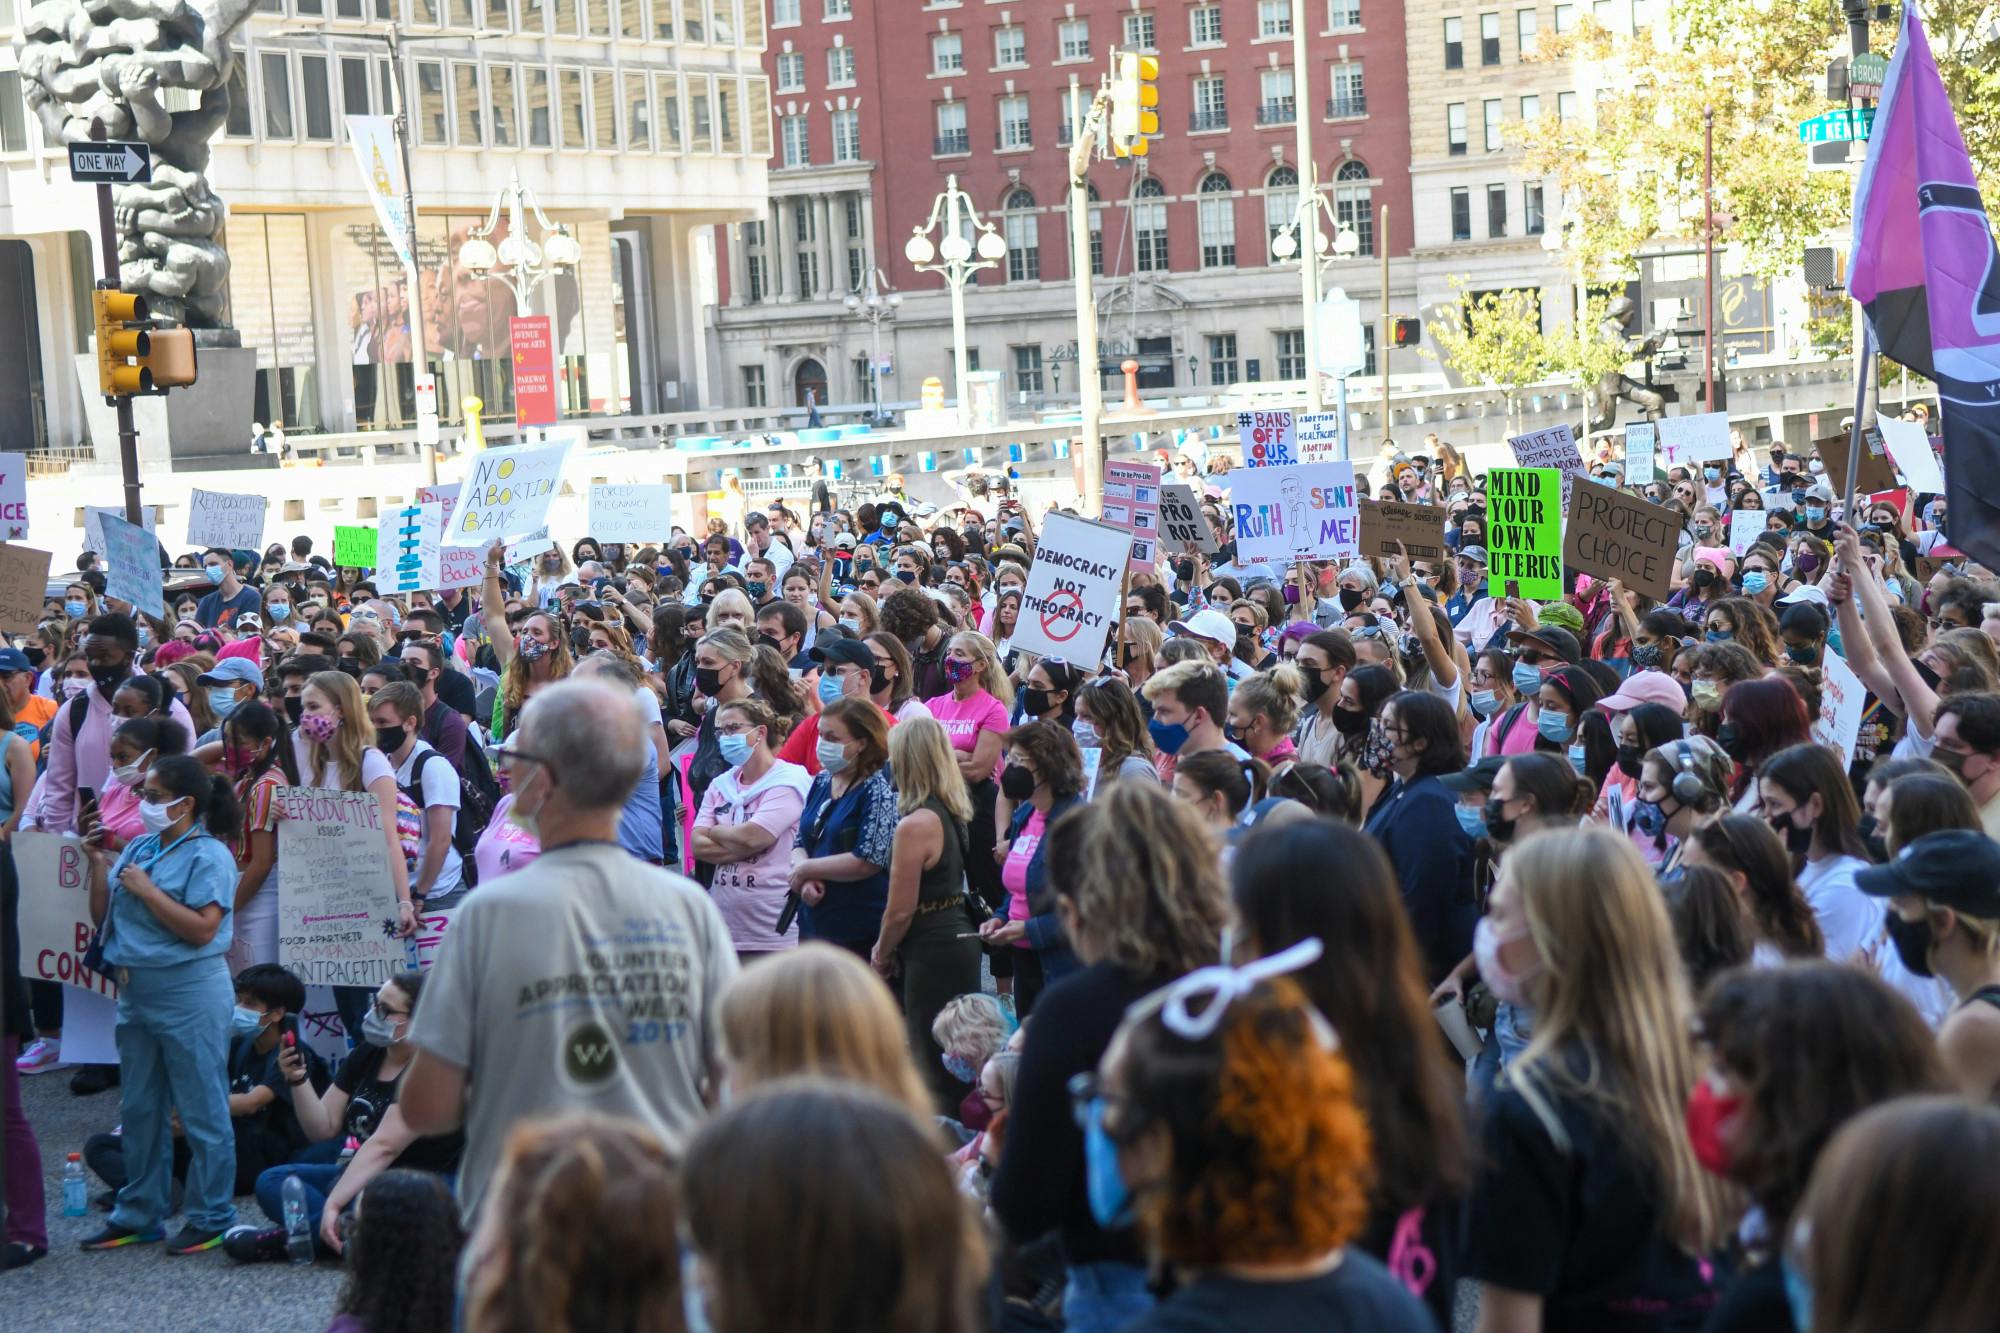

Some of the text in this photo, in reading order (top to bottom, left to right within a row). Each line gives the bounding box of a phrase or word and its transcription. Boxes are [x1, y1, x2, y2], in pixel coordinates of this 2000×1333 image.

[1858, 65, 1883, 82] BROAD
[1802, 121, 1871, 140] JF KENNE
[78, 154, 126, 170] ONE WAY
[514, 331, 539, 339] AVENUE
[530, 340, 546, 348] ARTS
[517, 376, 546, 384] PARKWAY
[517, 385, 548, 393] MUSEUMS
[1255, 412, 1291, 428] BANS
[1299, 414, 1334, 423] ABORTION
[1253, 428, 1285, 443] OFF
[1298, 430, 1337, 440] HEALTHCARE
[1511, 430, 1567, 453] NOLITE TE
[1252, 444, 1289, 459] OUR
[1302, 443, 1332, 452] ABORTION
[1516, 444, 1577, 466] BASTARDES
[475, 458, 516, 485] NO
[467, 479, 556, 508] ABORTION
[594, 487, 634, 499] FORCED
[1491, 471, 1541, 497] MIND
[193, 489, 264, 512] REPRODUCTIVE
[1310, 485, 1354, 509] SENT
[205, 511, 257, 526] FREEDOM
[1160, 504, 1193, 522] PRO
[1236, 503, 1284, 538] RUTH
[1491, 498, 1544, 524] YOUR
[1577, 491, 1673, 547] PROTECT
[462, 511, 516, 532] BANS
[1319, 516, 1357, 545] ME!
[193, 529, 262, 548] HUMAN RIGHT
[1167, 524, 1203, 541] ROE
[1492, 524, 1535, 551] OWN
[1036, 547, 1117, 580] DEMOCRACY
[1491, 552, 1560, 580] UTERUS
[1577, 533, 1658, 582] CHOICE
[442, 564, 482, 583] Back
[1054, 577, 1087, 597] NOT
[1024, 595, 1103, 628] THEOCRACY
[276, 786, 315, 798] EVERY
[277, 799, 382, 831] REPRODUCTIVE
[732, 875, 741, 887] &
[746, 875, 757, 888] R
[279, 930, 363, 946] FOOD APARTHEID
[289, 940, 388, 961] COMPASSION
